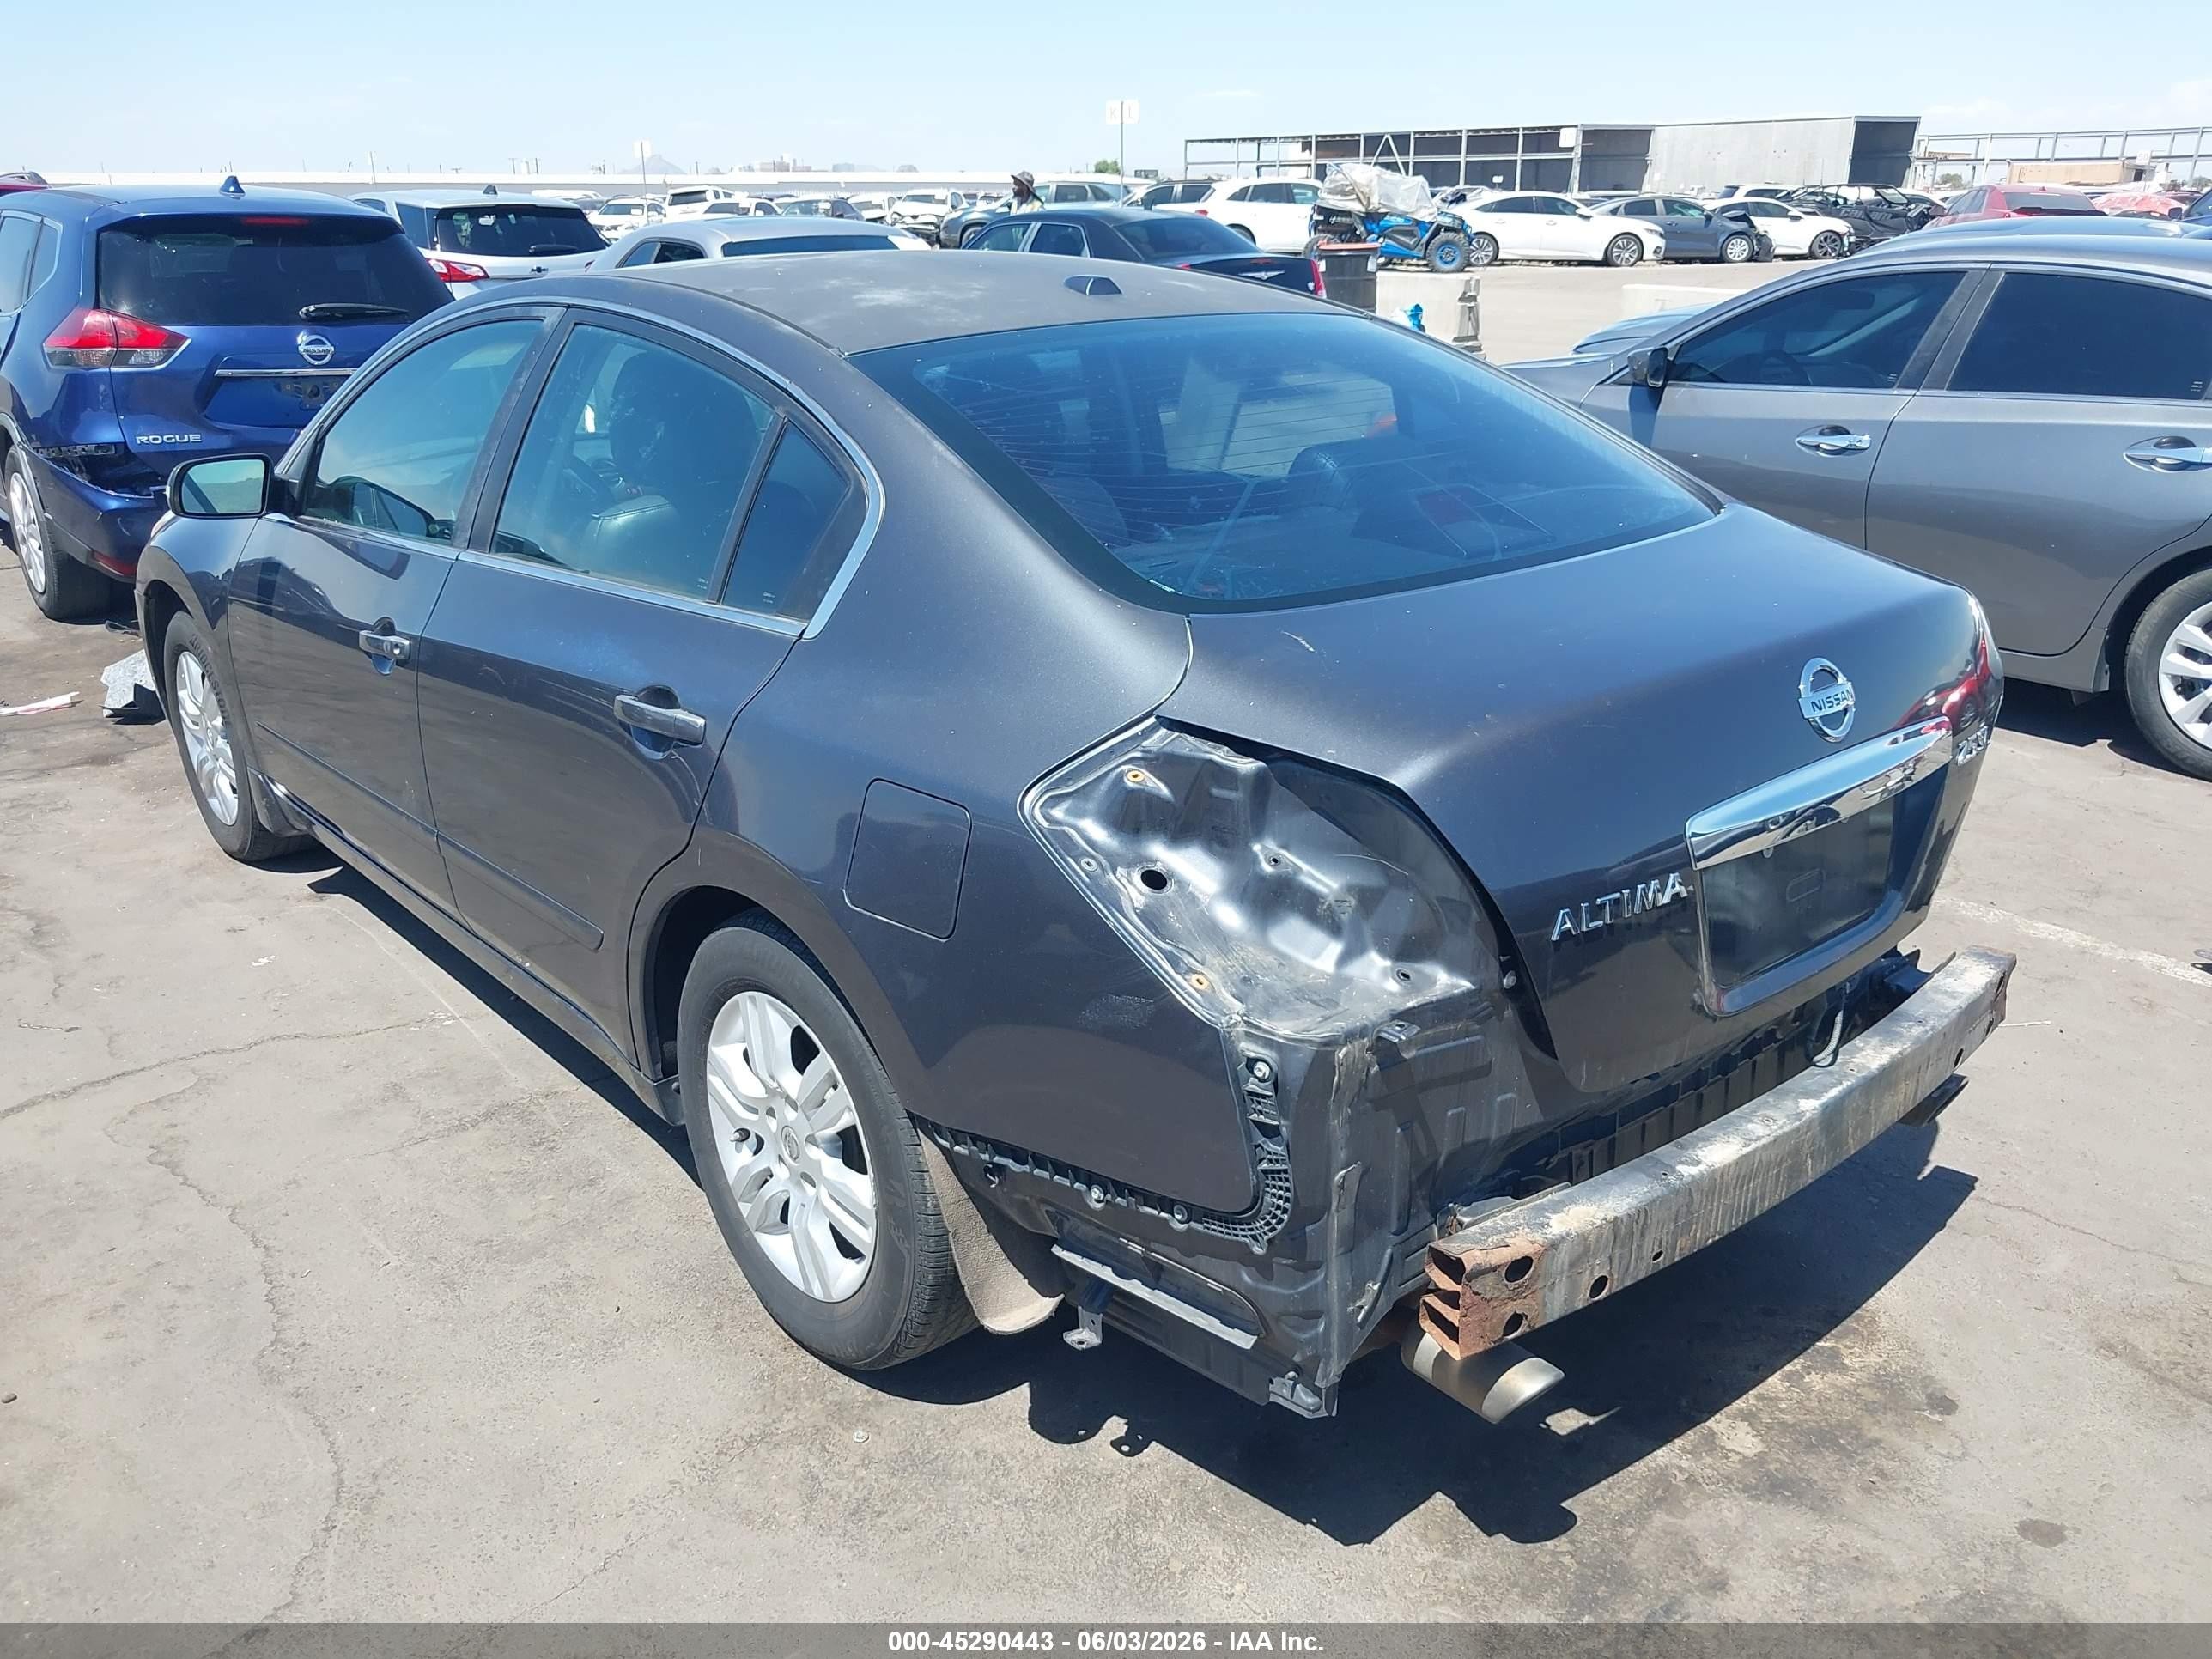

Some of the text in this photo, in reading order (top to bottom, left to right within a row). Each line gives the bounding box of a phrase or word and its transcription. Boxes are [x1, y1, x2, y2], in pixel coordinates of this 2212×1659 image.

[1109, 106, 1117, 121] K
[136, 434, 202, 445] ROGUE
[1810, 688, 1854, 712] NISSAN
[1551, 872, 1689, 941] ALTIMA
